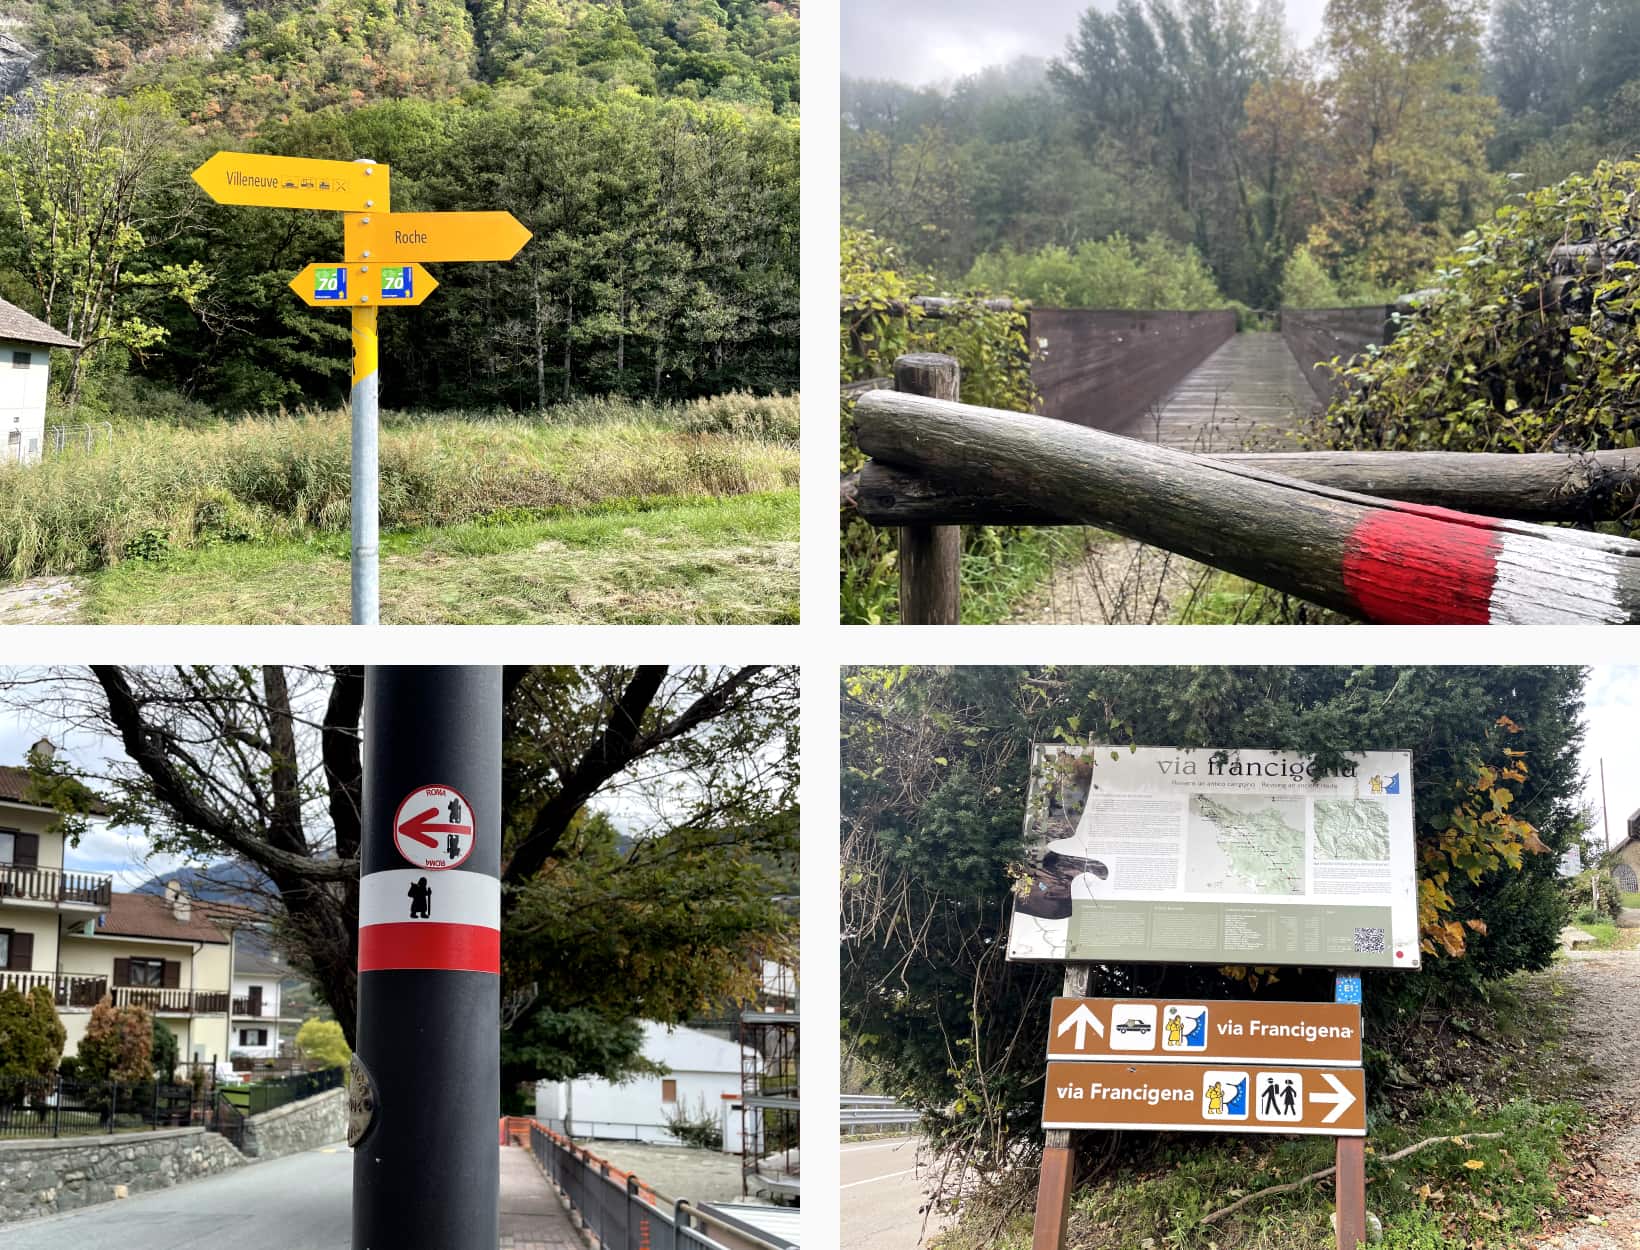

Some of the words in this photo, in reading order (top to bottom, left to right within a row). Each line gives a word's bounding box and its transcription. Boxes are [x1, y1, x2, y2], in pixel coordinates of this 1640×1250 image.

[226, 170, 278, 189] Villeneuve
[395, 230, 427, 245] Roche
[319, 278, 338, 290] 70
[384, 277, 404, 289] 70
[1157, 757, 1197, 775] via
[426, 789, 446, 797] ROMA
[425, 859, 446, 867] ROMA
[1217, 1019, 1243, 1035] via
[1250, 1020, 1352, 1042] Francigena
[1057, 1082, 1084, 1099] via
[1090, 1082, 1195, 1105] Francigena
